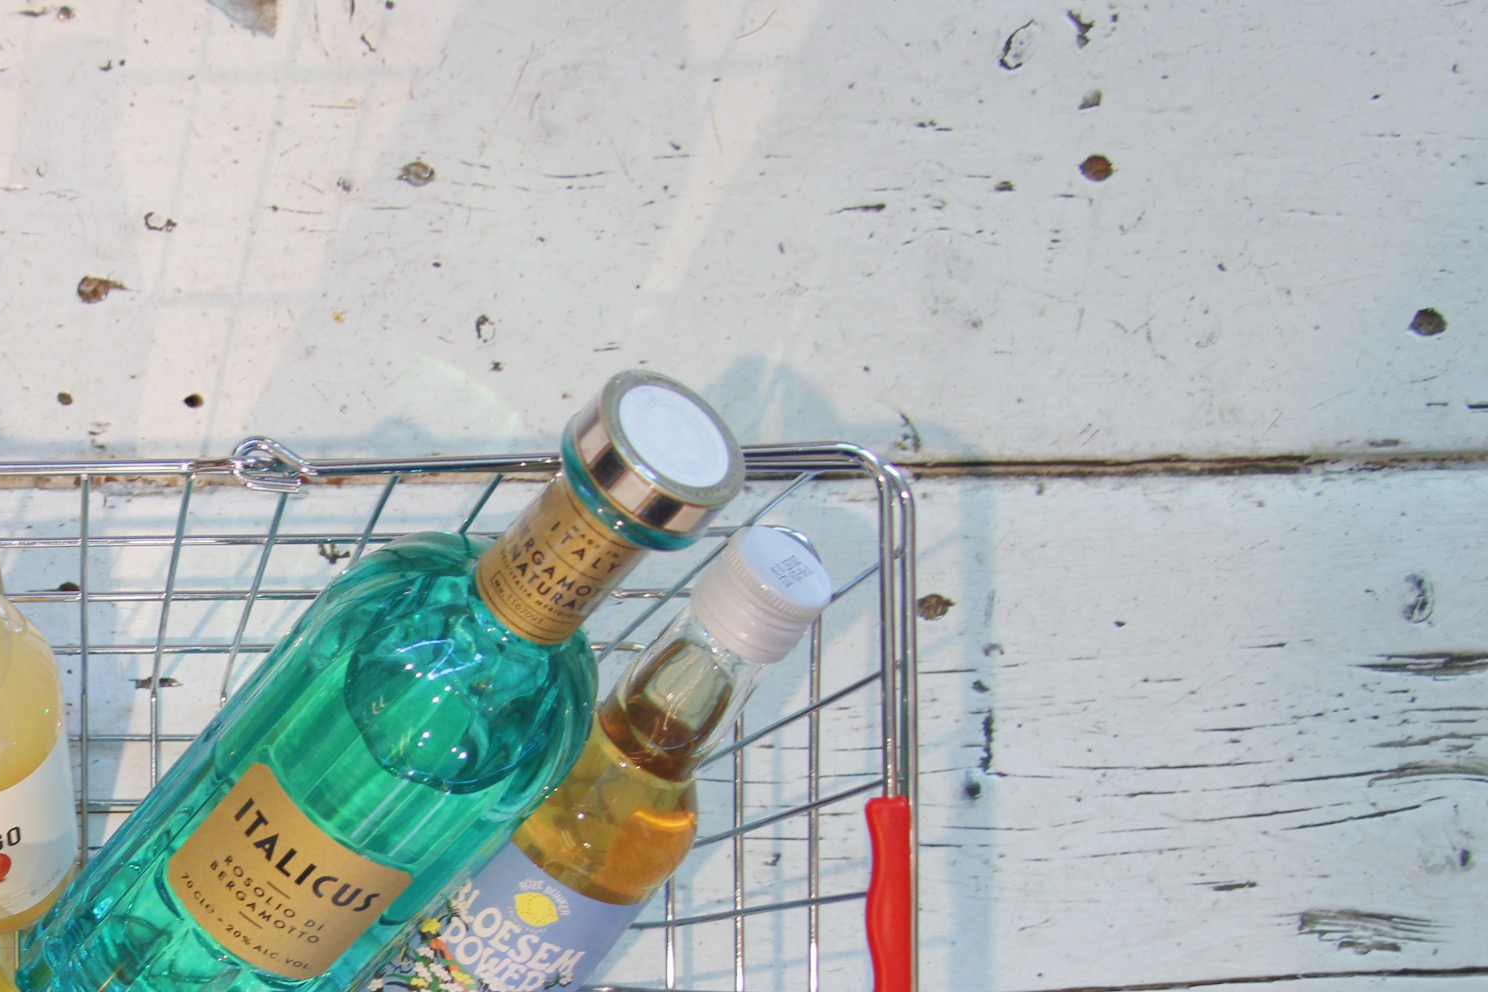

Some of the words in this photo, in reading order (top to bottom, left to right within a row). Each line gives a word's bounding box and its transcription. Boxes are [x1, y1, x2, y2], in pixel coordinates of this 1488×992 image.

[551, 521, 622, 574] ITALY
[224, 855, 296, 918] ROSOLIO
[304, 919, 325, 931] DI
[234, 798, 380, 912] ITALICUS
[181, 873, 193, 889] 70
[225, 924, 251, 947] 20%
[210, 860, 320, 944] BERGAMOTTO
